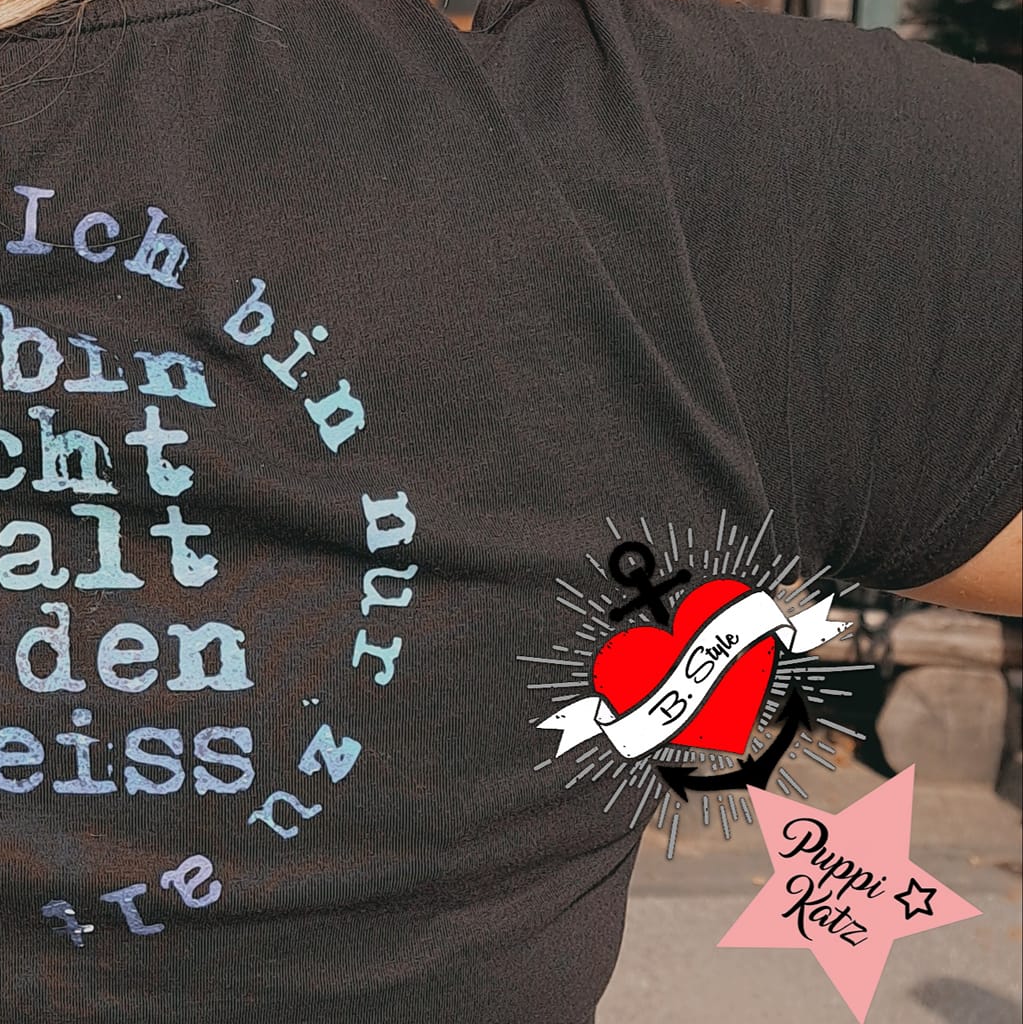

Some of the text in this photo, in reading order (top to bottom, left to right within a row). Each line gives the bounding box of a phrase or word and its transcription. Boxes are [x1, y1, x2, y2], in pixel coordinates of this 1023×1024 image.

[5, 185, 189, 290] Ich
[223, 277, 366, 453] bin
[353, 490, 417, 687] nur
[15, 601, 255, 694] den
[248, 723, 361, 840] zu
[41, 854, 224, 949] alt
